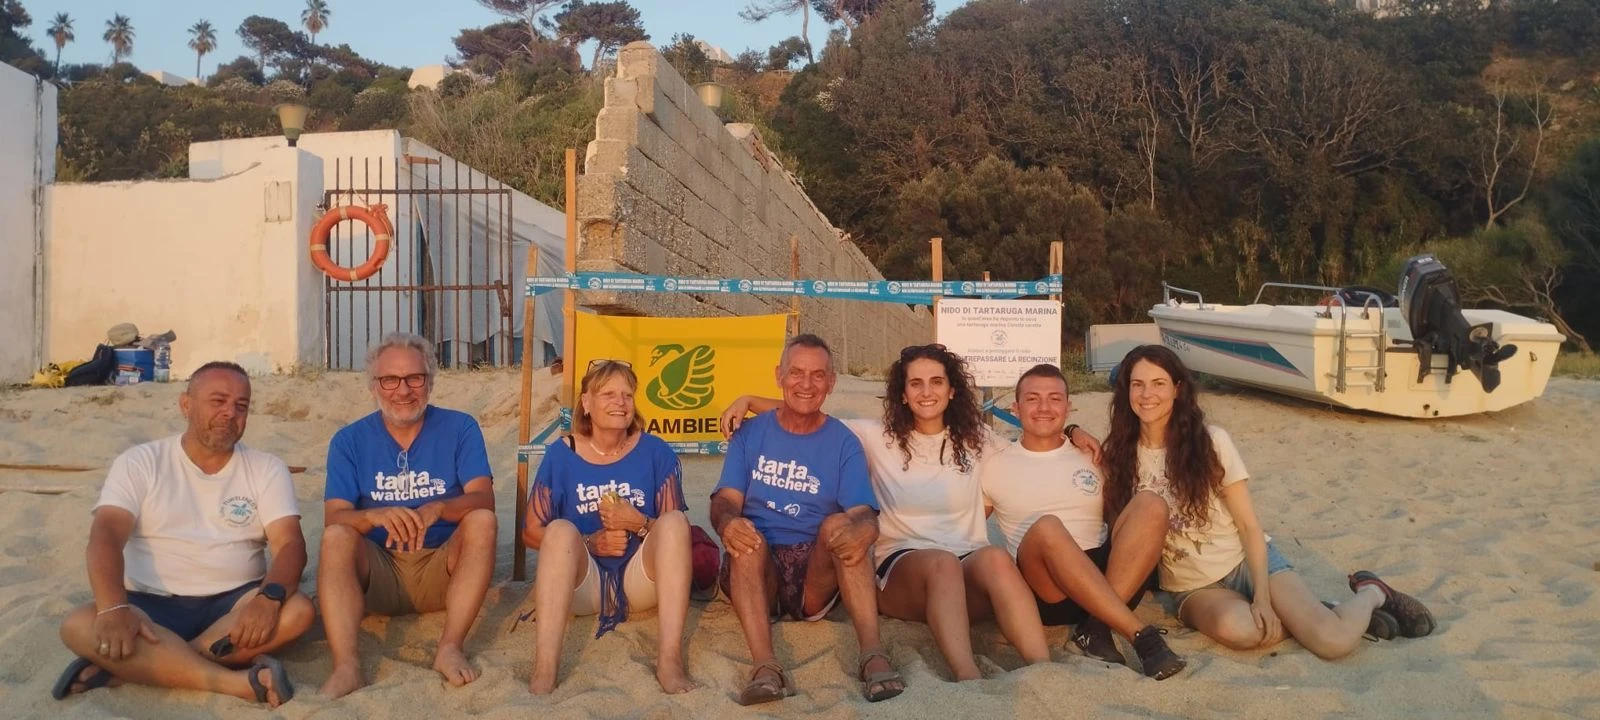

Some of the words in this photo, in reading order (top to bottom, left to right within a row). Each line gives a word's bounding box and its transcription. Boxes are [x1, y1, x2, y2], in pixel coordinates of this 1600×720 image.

[973, 307, 1023, 315] TARTARUGA
[1025, 307, 1057, 315] MARINA
[1008, 355, 1017, 363] LA
[1020, 355, 1057, 363] RECINZIONE
[758, 455, 808, 480] tarta
[375, 470, 430, 490] tarta
[576, 479, 631, 501] tarta
[752, 469, 819, 495] watchers
[370, 485, 447, 502] watchers
